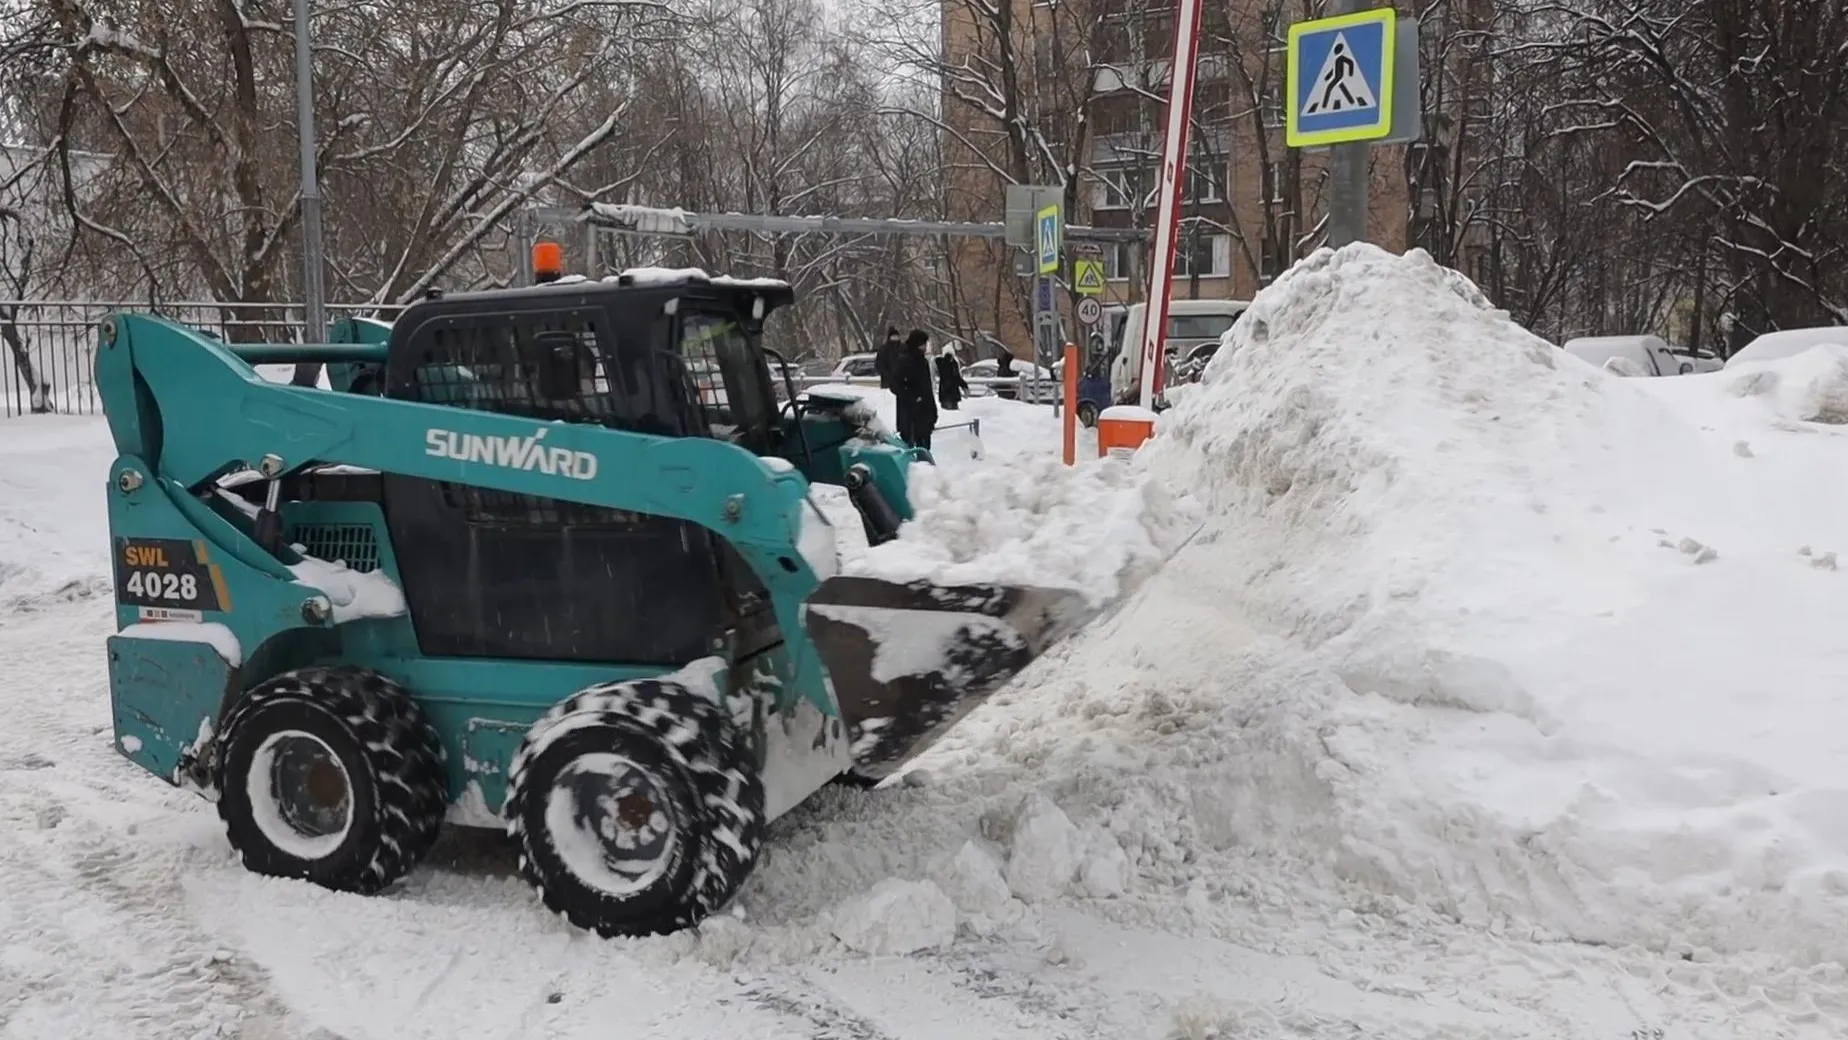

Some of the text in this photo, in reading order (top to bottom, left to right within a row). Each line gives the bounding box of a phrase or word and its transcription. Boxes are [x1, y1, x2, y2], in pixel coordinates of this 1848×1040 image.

[1081, 304, 1098, 316] 40
[425, 428, 598, 480] SUNWARD
[126, 546, 169, 567] SWL
[126, 571, 198, 600] 4028
